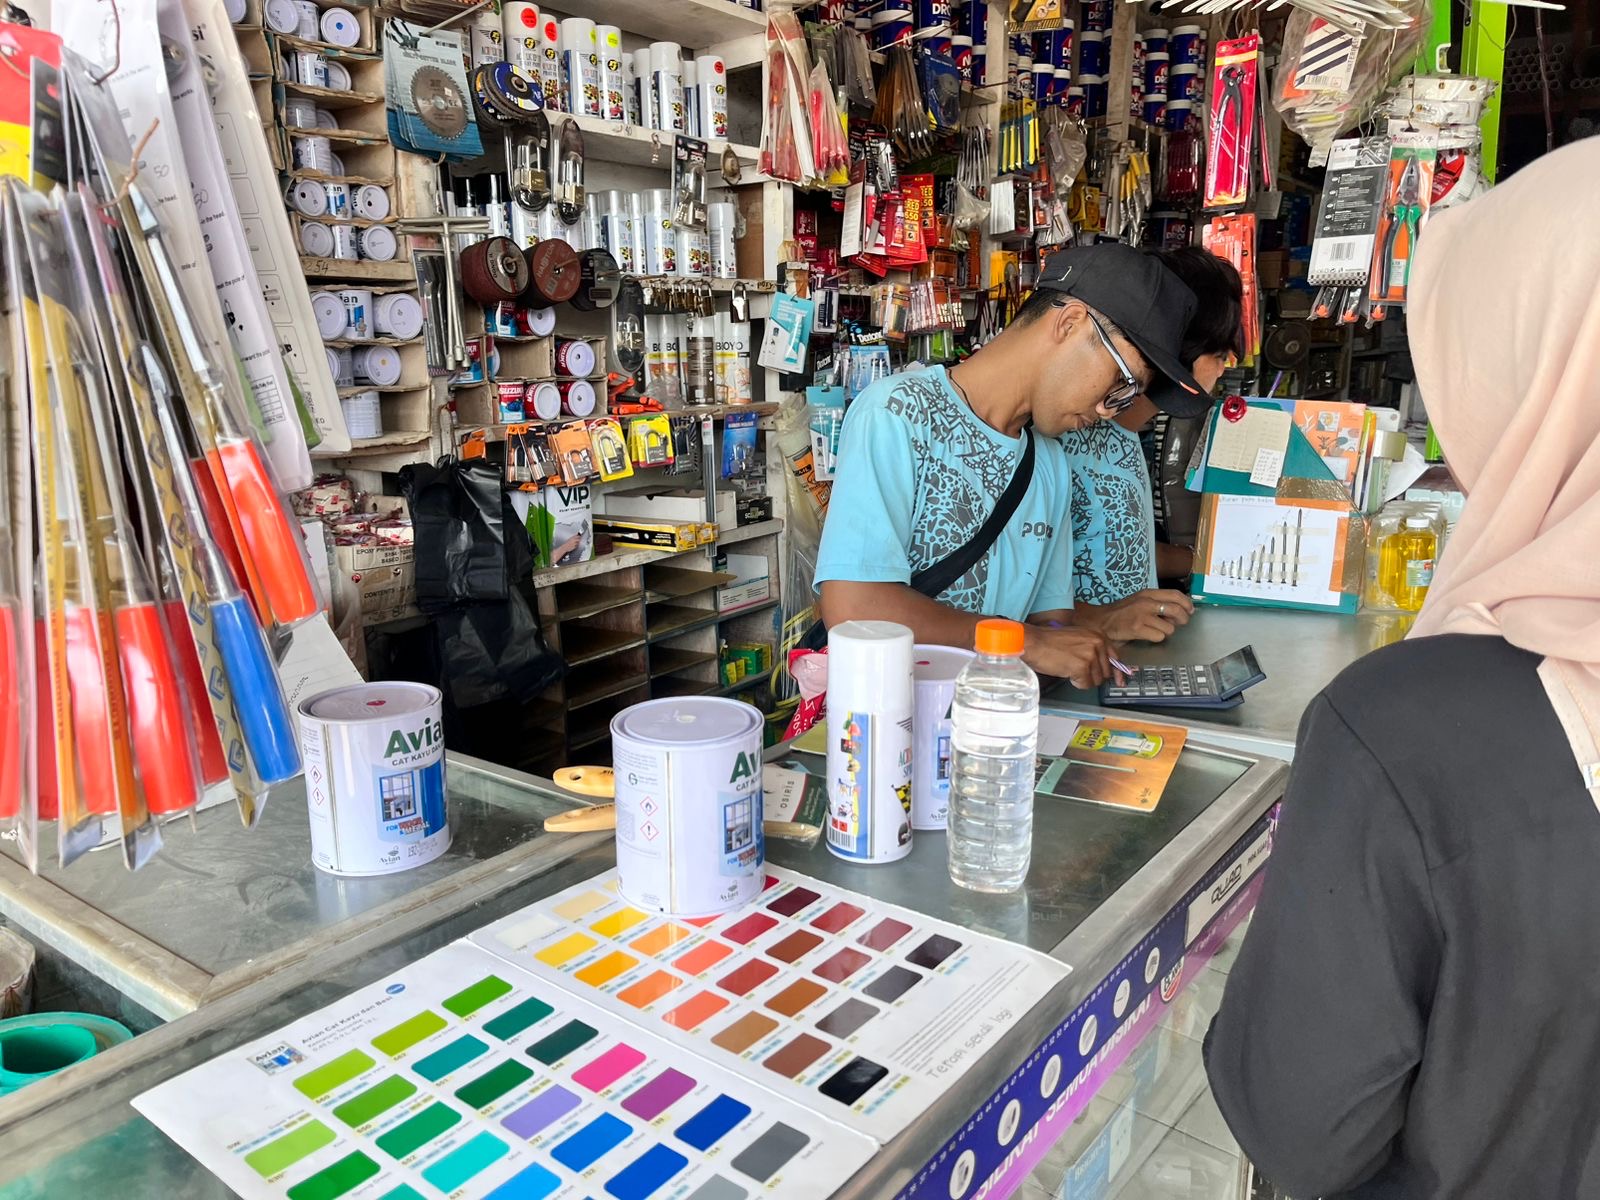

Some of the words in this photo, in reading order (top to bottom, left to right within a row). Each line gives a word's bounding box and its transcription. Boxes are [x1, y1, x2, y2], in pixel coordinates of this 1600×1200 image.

[557, 486, 589, 507] VIP
[392, 757, 409, 766] CAT
[386, 824, 399, 832] FOR
[301, 1029, 325, 1044] Avian
[324, 1021, 338, 1033] Cat
[339, 1012, 360, 1024] Kayu
